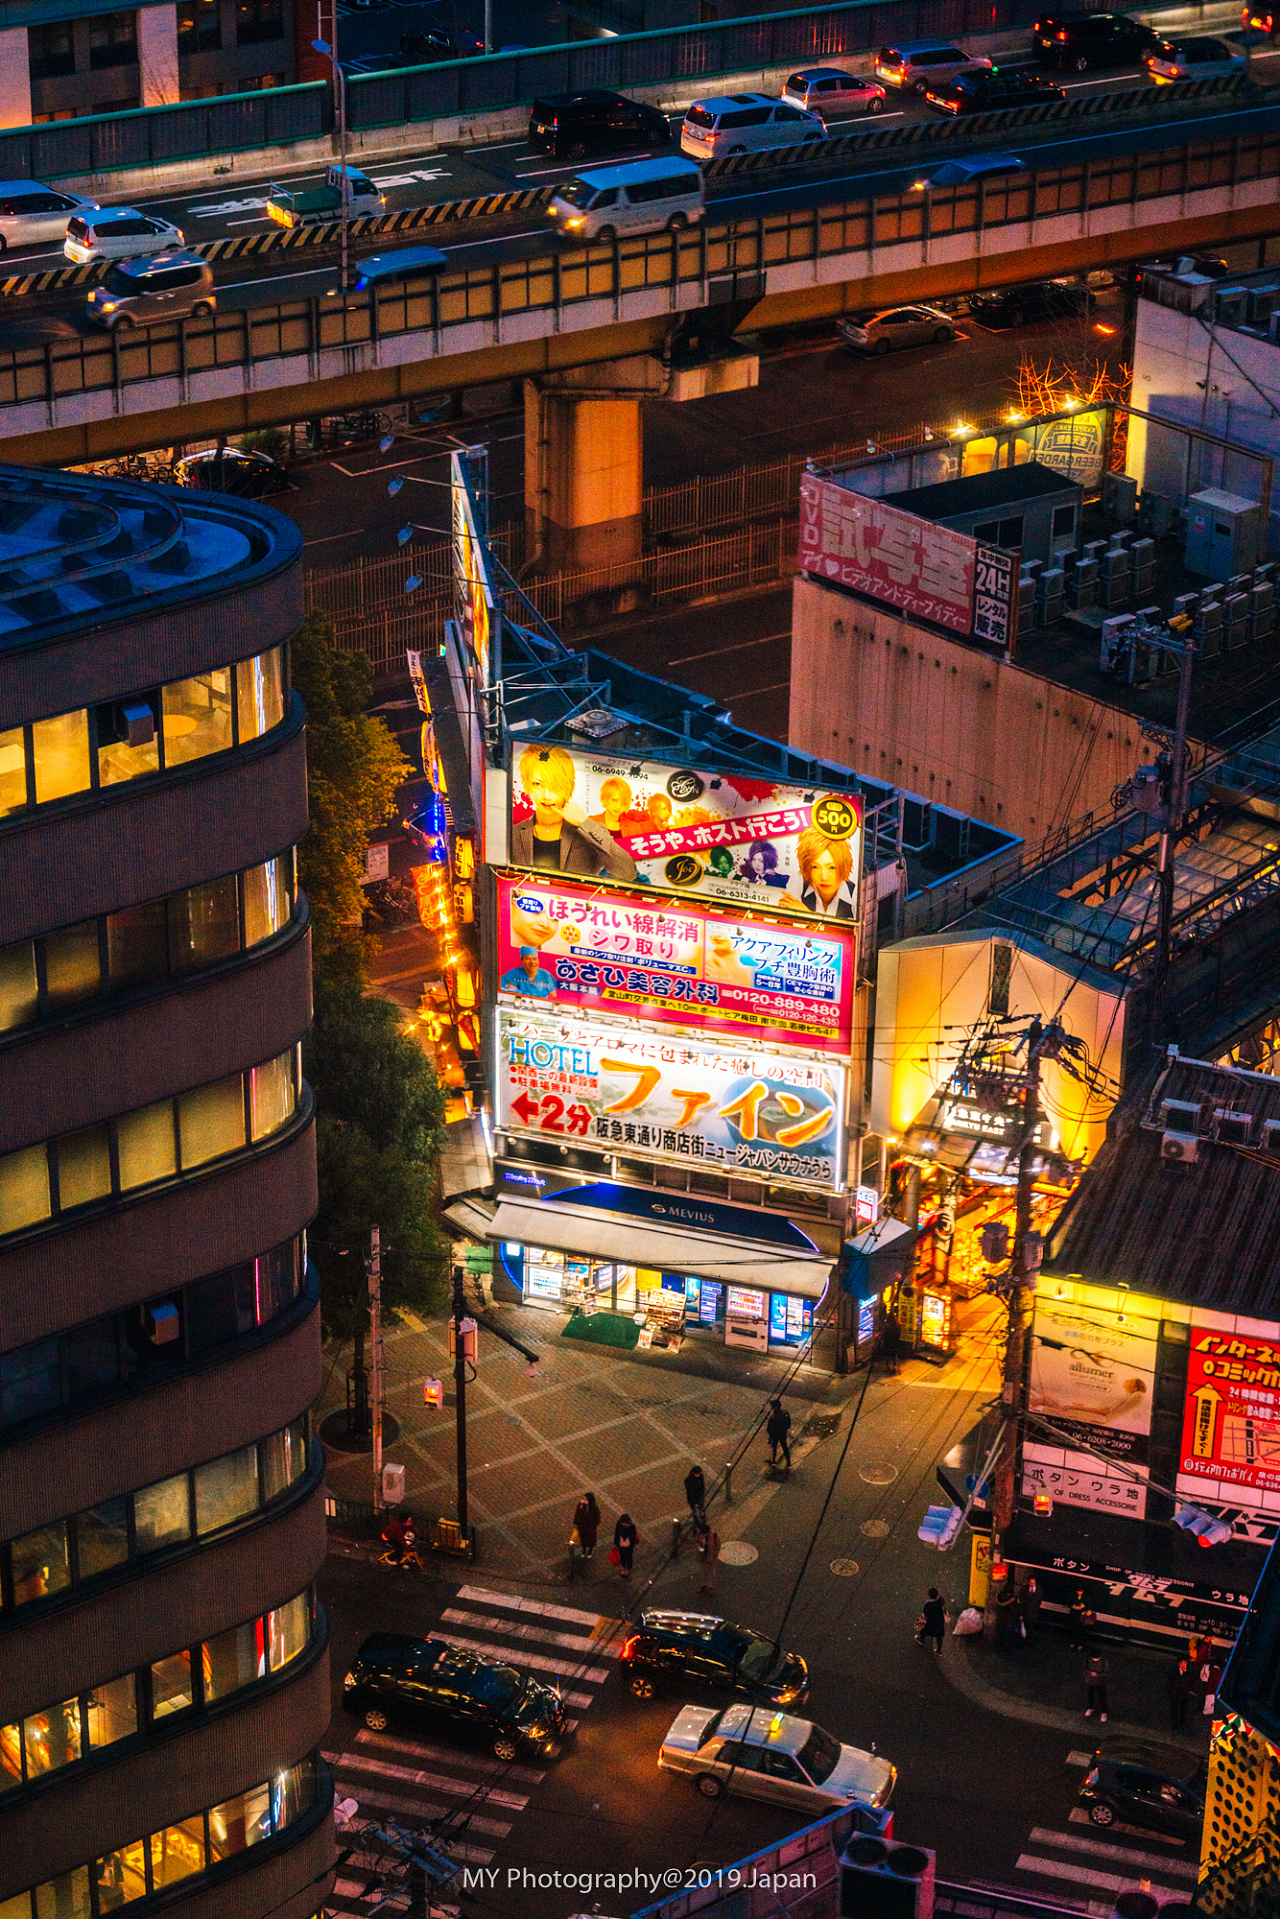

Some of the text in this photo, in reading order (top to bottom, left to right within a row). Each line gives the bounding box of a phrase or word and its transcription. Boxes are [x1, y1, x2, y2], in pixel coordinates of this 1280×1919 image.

[820, 487, 972, 608] 試写室
[976, 562, 1011, 596] 24H
[977, 597, 1007, 619] レンタル
[976, 612, 1006, 641] 販売
[817, 810, 851, 828] 500
[715, 887, 770, 903] 06-6313-4141
[549, 899, 699, 943] ほうれい線解消
[591, 930, 674, 960] シワ取り
[730, 936, 838, 966] アクアフィリング
[556, 959, 719, 1004] あさひ美容外科
[733, 989, 841, 1017] 0120-889-480
[509, 1037, 599, 1077] HOTEL
[517, 1076, 573, 1095] 駐車場無料
[540, 1094, 592, 1136] 2分
[599, 1057, 833, 1148] ファイン
[981, 1125, 1006, 1136] EAST
[596, 1116, 832, 1179] 阪急東通り商店街ニュージャパンサウナうら
[668, 1206, 715, 1224] MEVIUS
[1068, 1362, 1115, 1379] allumer
[1032, 1469, 1139, 1500] ボタン ウラ地
[1054, 1488, 1065, 1497] OF
[1068, 1491, 1091, 1502] DRESS
[1095, 1497, 1138, 1512] ACCESSORIE
[1052, 1557, 1091, 1572] ボタン
[1211, 1589, 1250, 1606] ウラ地
